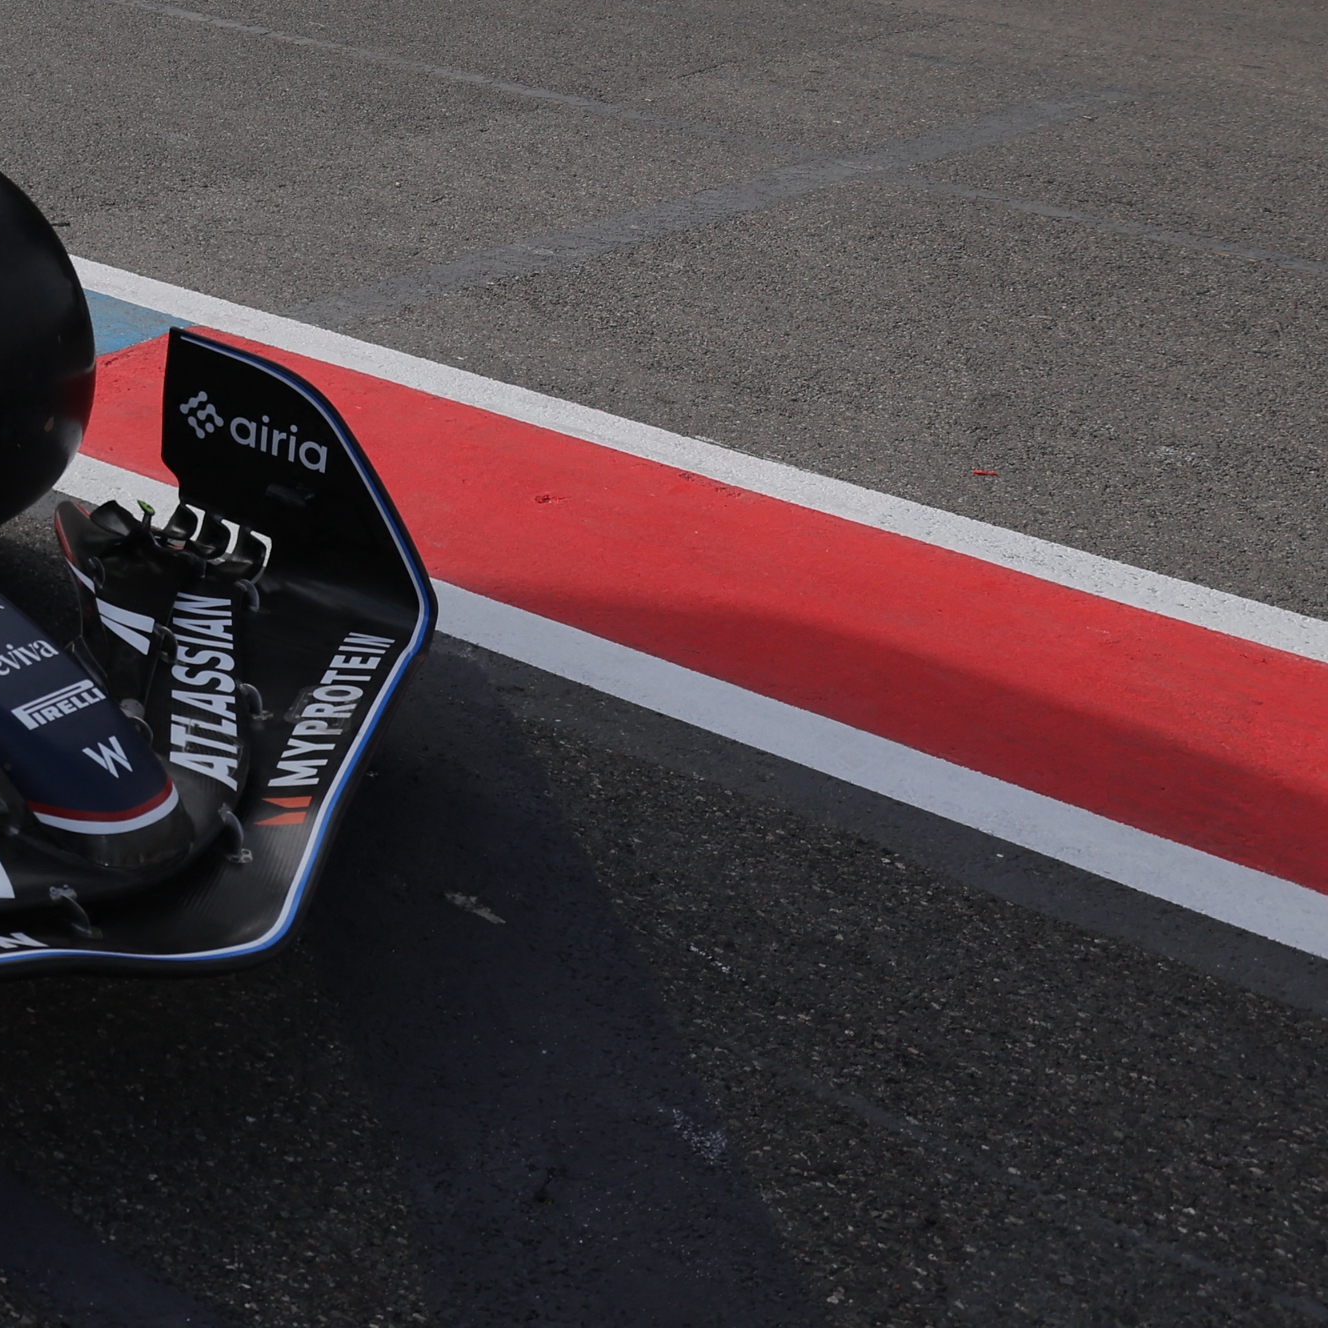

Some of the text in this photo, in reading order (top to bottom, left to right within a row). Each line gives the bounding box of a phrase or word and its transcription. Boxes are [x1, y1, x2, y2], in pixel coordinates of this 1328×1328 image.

[230, 415, 328, 473] airia
[11, 679, 106, 731] PIRELLI
[169, 593, 239, 792] ATLASSIAN
[267, 632, 396, 787] MYPROTEIN
